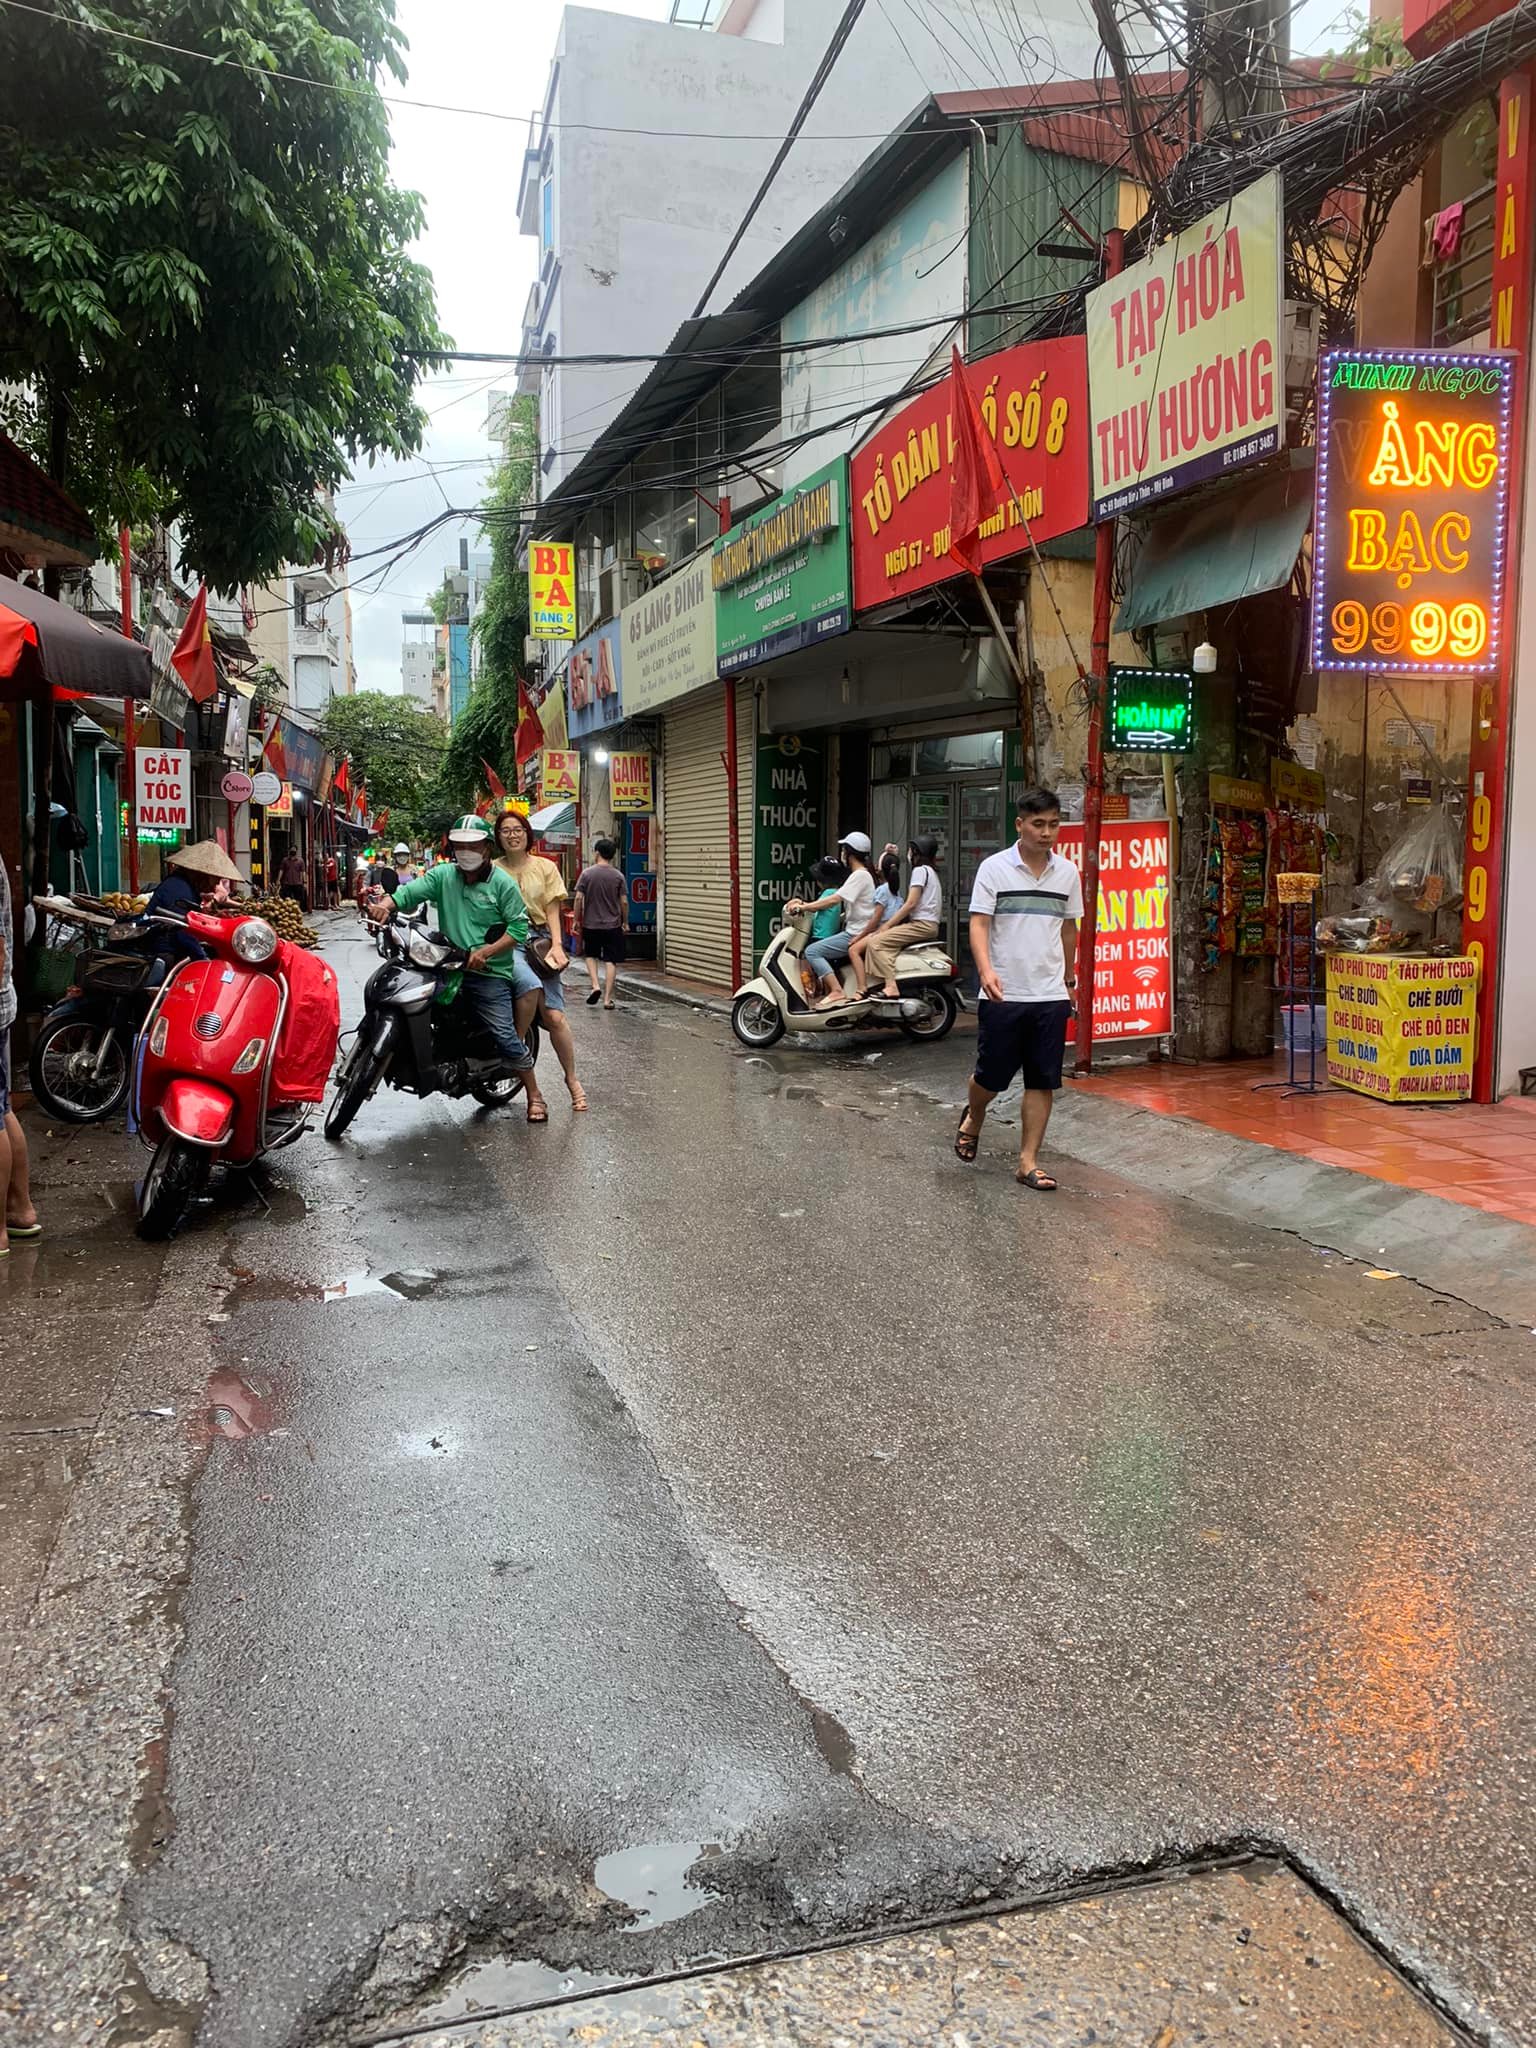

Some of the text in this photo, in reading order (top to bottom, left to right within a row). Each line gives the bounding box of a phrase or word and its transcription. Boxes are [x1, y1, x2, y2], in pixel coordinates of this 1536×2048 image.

[1111, 224, 1245, 376] TẠP HÓA
[1418, 366, 1503, 400] NGỌC
[1097, 400, 1150, 487] THU
[1158, 339, 1273, 462] HƯƠNG
[862, 453, 893, 536] TỔ
[891, 422, 941, 503] DÂN
[1003, 371, 1048, 448] SỐ
[1045, 397, 1068, 455] 8
[534, 547, 570, 575] BI
[909, 539, 922, 568] 67
[1348, 509, 1471, 589] BẠC
[535, 579, 571, 606] -A
[567, 613, 574, 623] 2
[630, 611, 641, 643] 65
[1331, 600, 1487, 657] 9999
[1162, 704, 1186, 729] MỸ
[144, 752, 181, 775] CẮT
[548, 753, 576, 770] BI
[613, 755, 649, 783] GAME
[144, 780, 182, 800] TÓC
[547, 772, 576, 789] -A
[771, 764, 807, 790] NHÀ
[616, 787, 649, 796] NET
[140, 806, 186, 824] NAM
[760, 798, 816, 828] THUỐC
[770, 843, 805, 869] ĐẠT
[1057, 837, 1167, 874] KHCH SẠN
[758, 872, 816, 901] CHUẨN
[1133, 874, 1169, 930] MỸ
[1127, 937, 1168, 961] 150K
[1094, 970, 1114, 988] IFI
[1092, 989, 1166, 1014] HANG MÁY
[1408, 984, 1463, 1007] CHÈ BƯỞI
[1095, 1021, 1122, 1034] 30M
[1402, 1017, 1422, 1037] CHÈ
[1446, 1018, 1469, 1035] ĐEN
